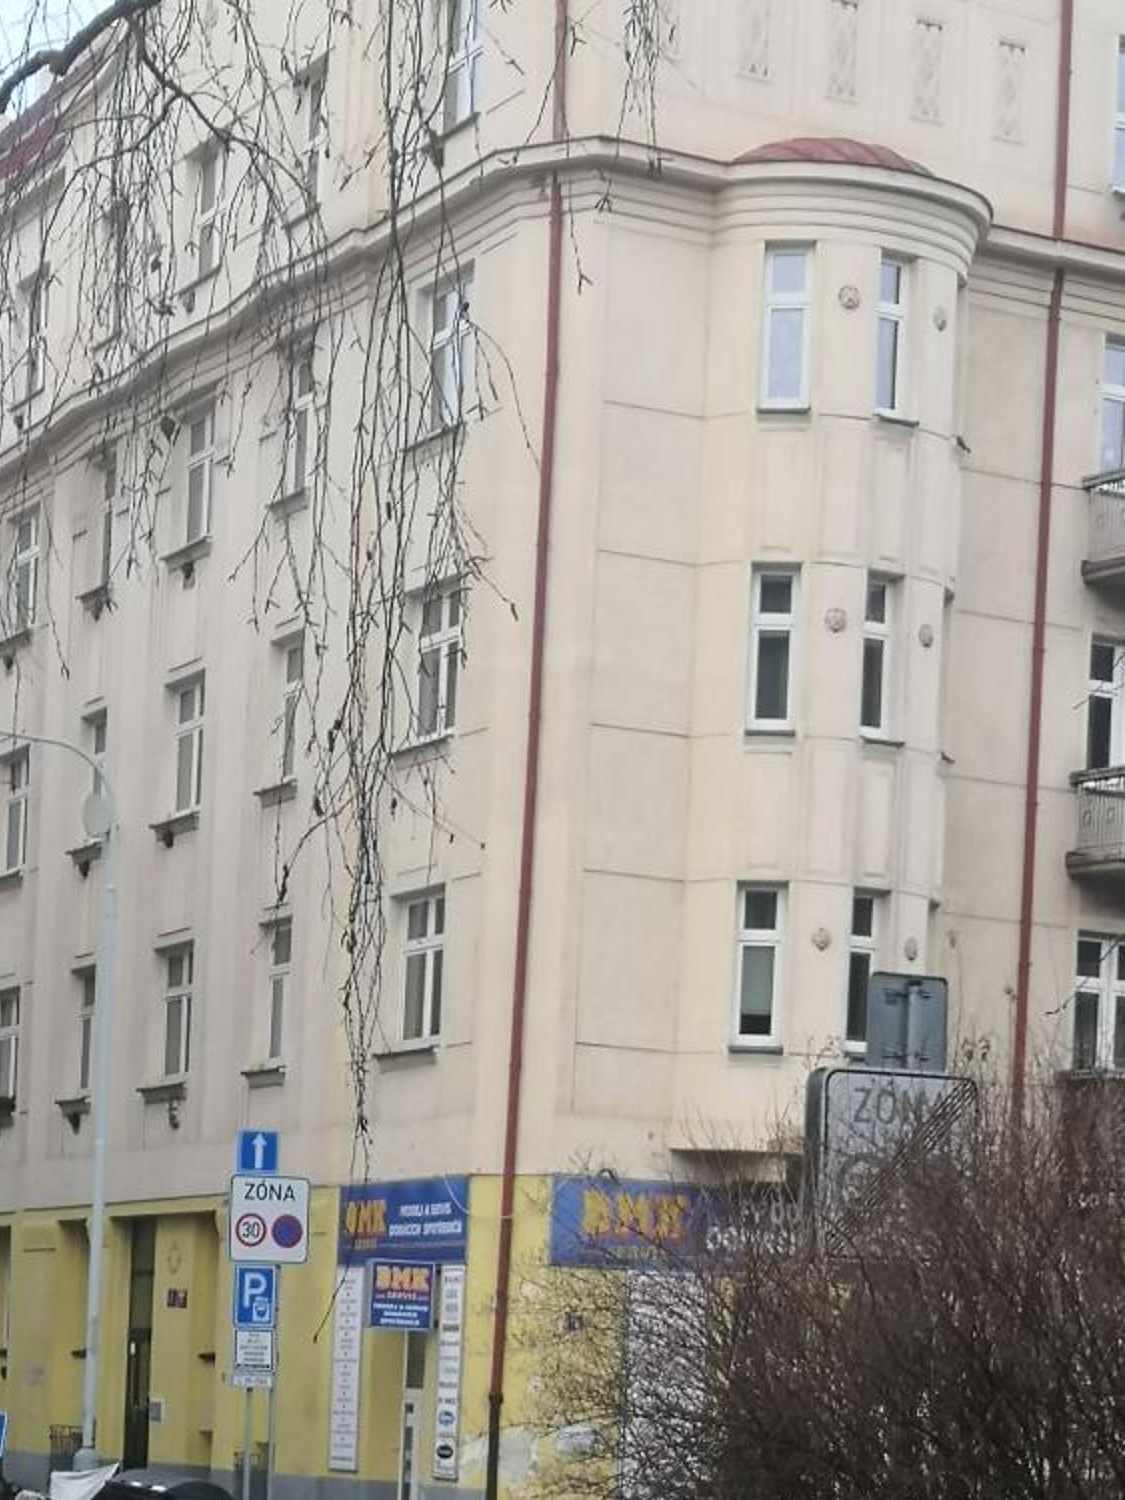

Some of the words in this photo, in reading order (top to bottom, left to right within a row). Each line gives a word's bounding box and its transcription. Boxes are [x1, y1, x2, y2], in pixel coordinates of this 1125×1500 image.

[244, 1180, 296, 1202] ZÓNA
[242, 1220, 261, 1239] 30
[243, 1272, 268, 1308] P
